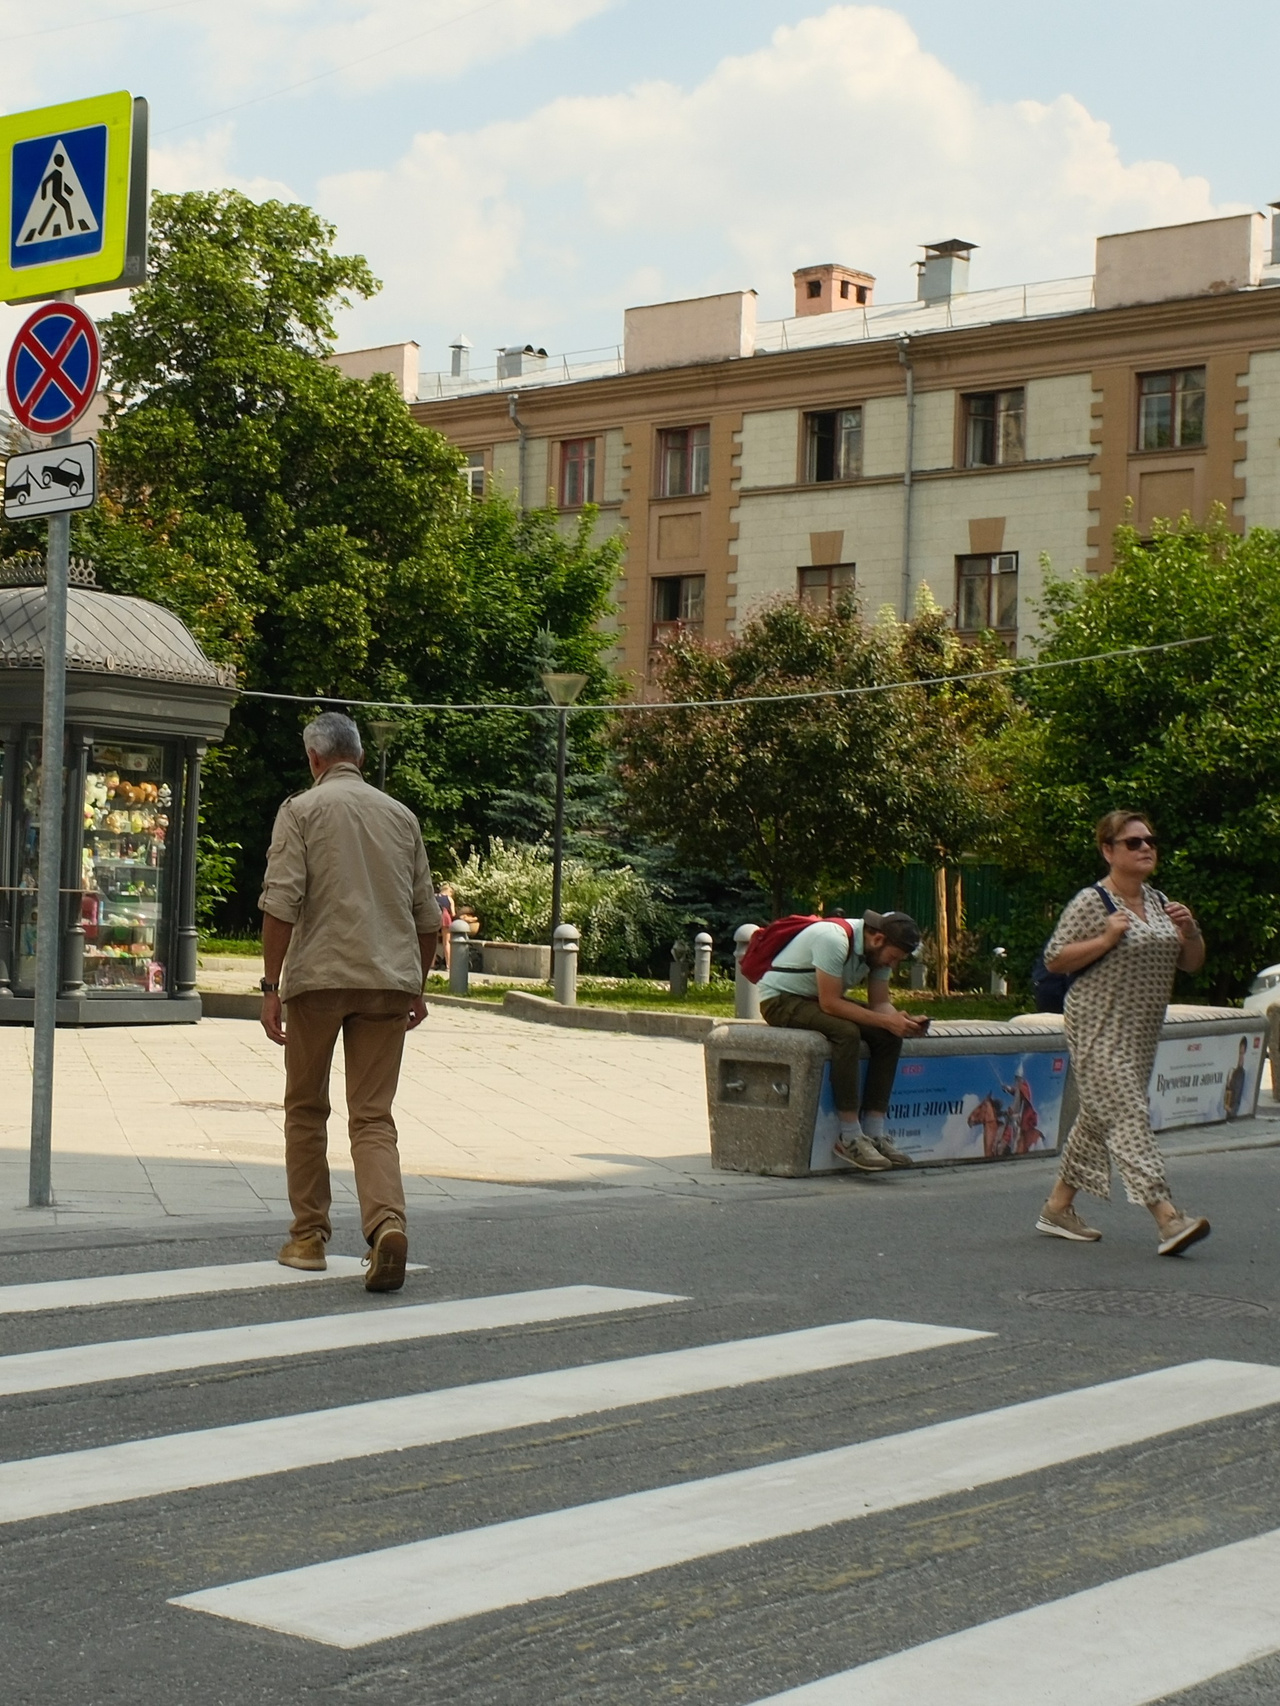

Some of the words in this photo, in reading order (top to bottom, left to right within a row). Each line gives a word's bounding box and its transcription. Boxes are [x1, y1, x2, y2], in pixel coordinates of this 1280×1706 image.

[1192, 1074, 1199, 1087] и
[886, 1104, 910, 1120] ена
[912, 1102, 921, 1117] и
[922, 1100, 964, 1116] эпохи
